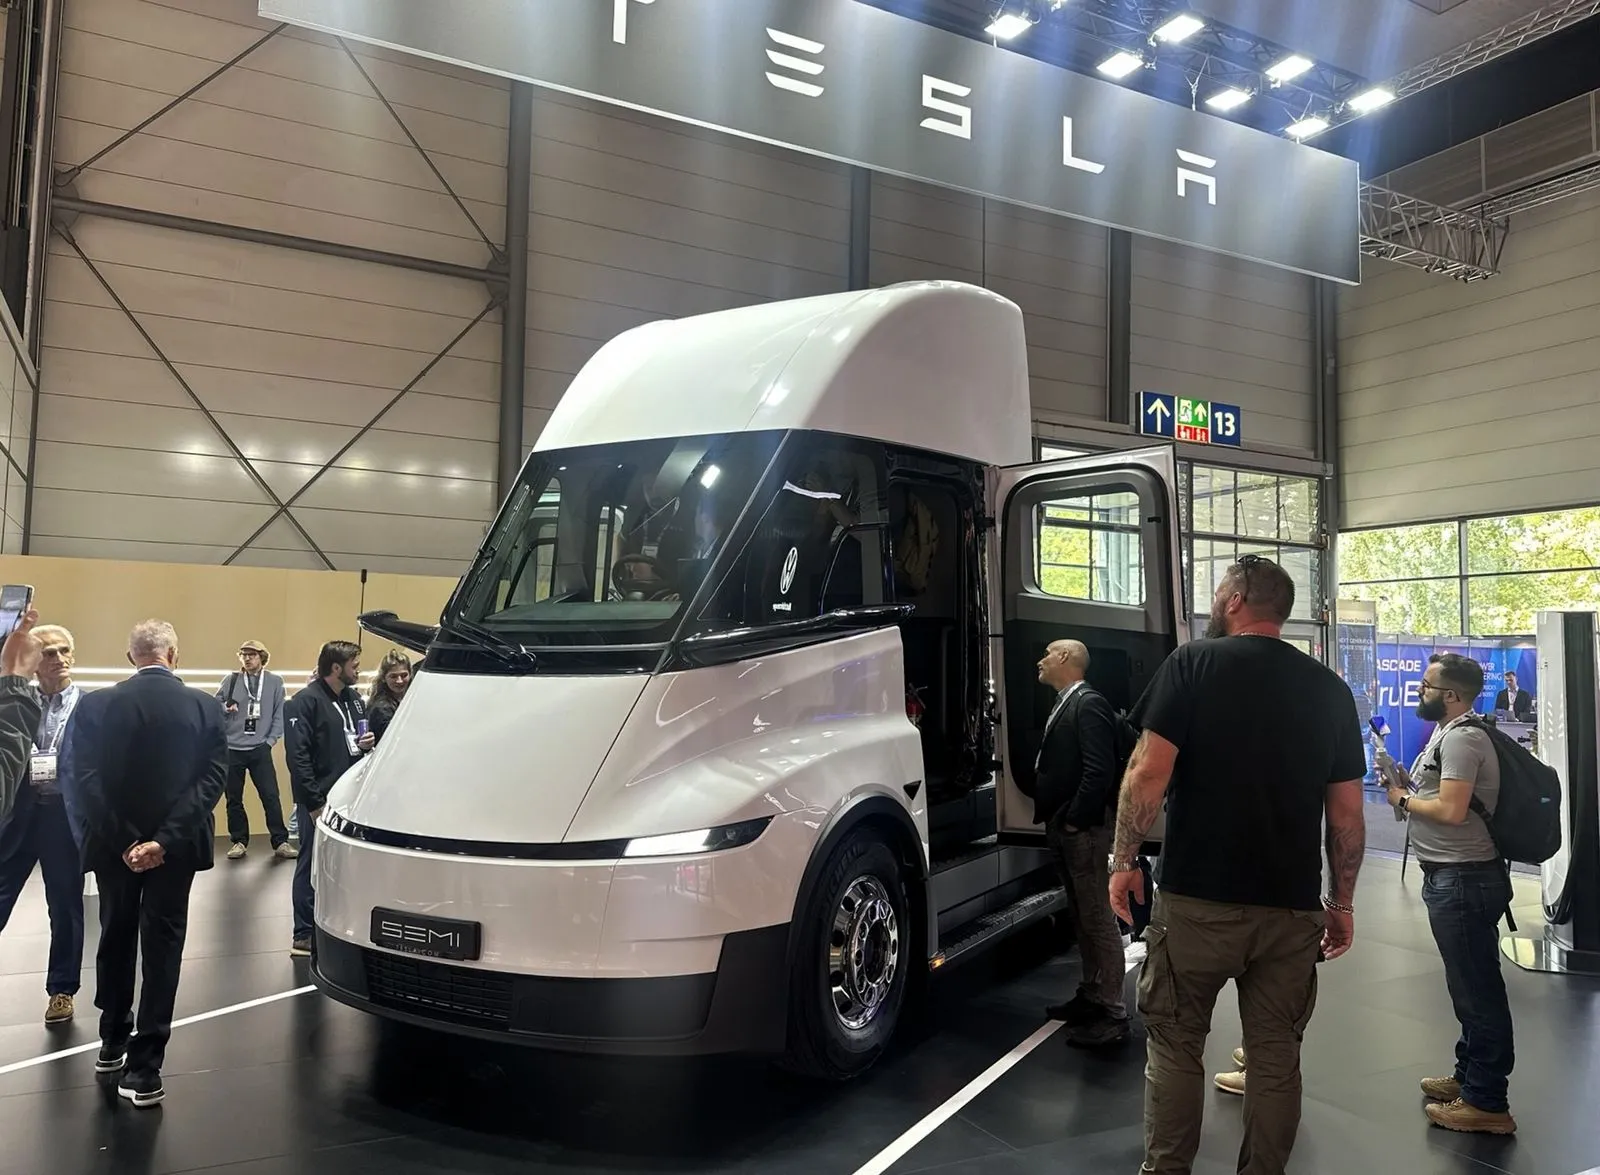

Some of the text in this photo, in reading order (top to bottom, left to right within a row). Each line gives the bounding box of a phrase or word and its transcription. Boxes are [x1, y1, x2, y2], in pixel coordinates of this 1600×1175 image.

[613, 0, 1217, 205] TESLA
[1214, 411, 1236, 436] 13
[1377, 659, 1422, 672] ASCADE
[1377, 680, 1422, 707] ruE
[382, 921, 460, 947] SEMI
